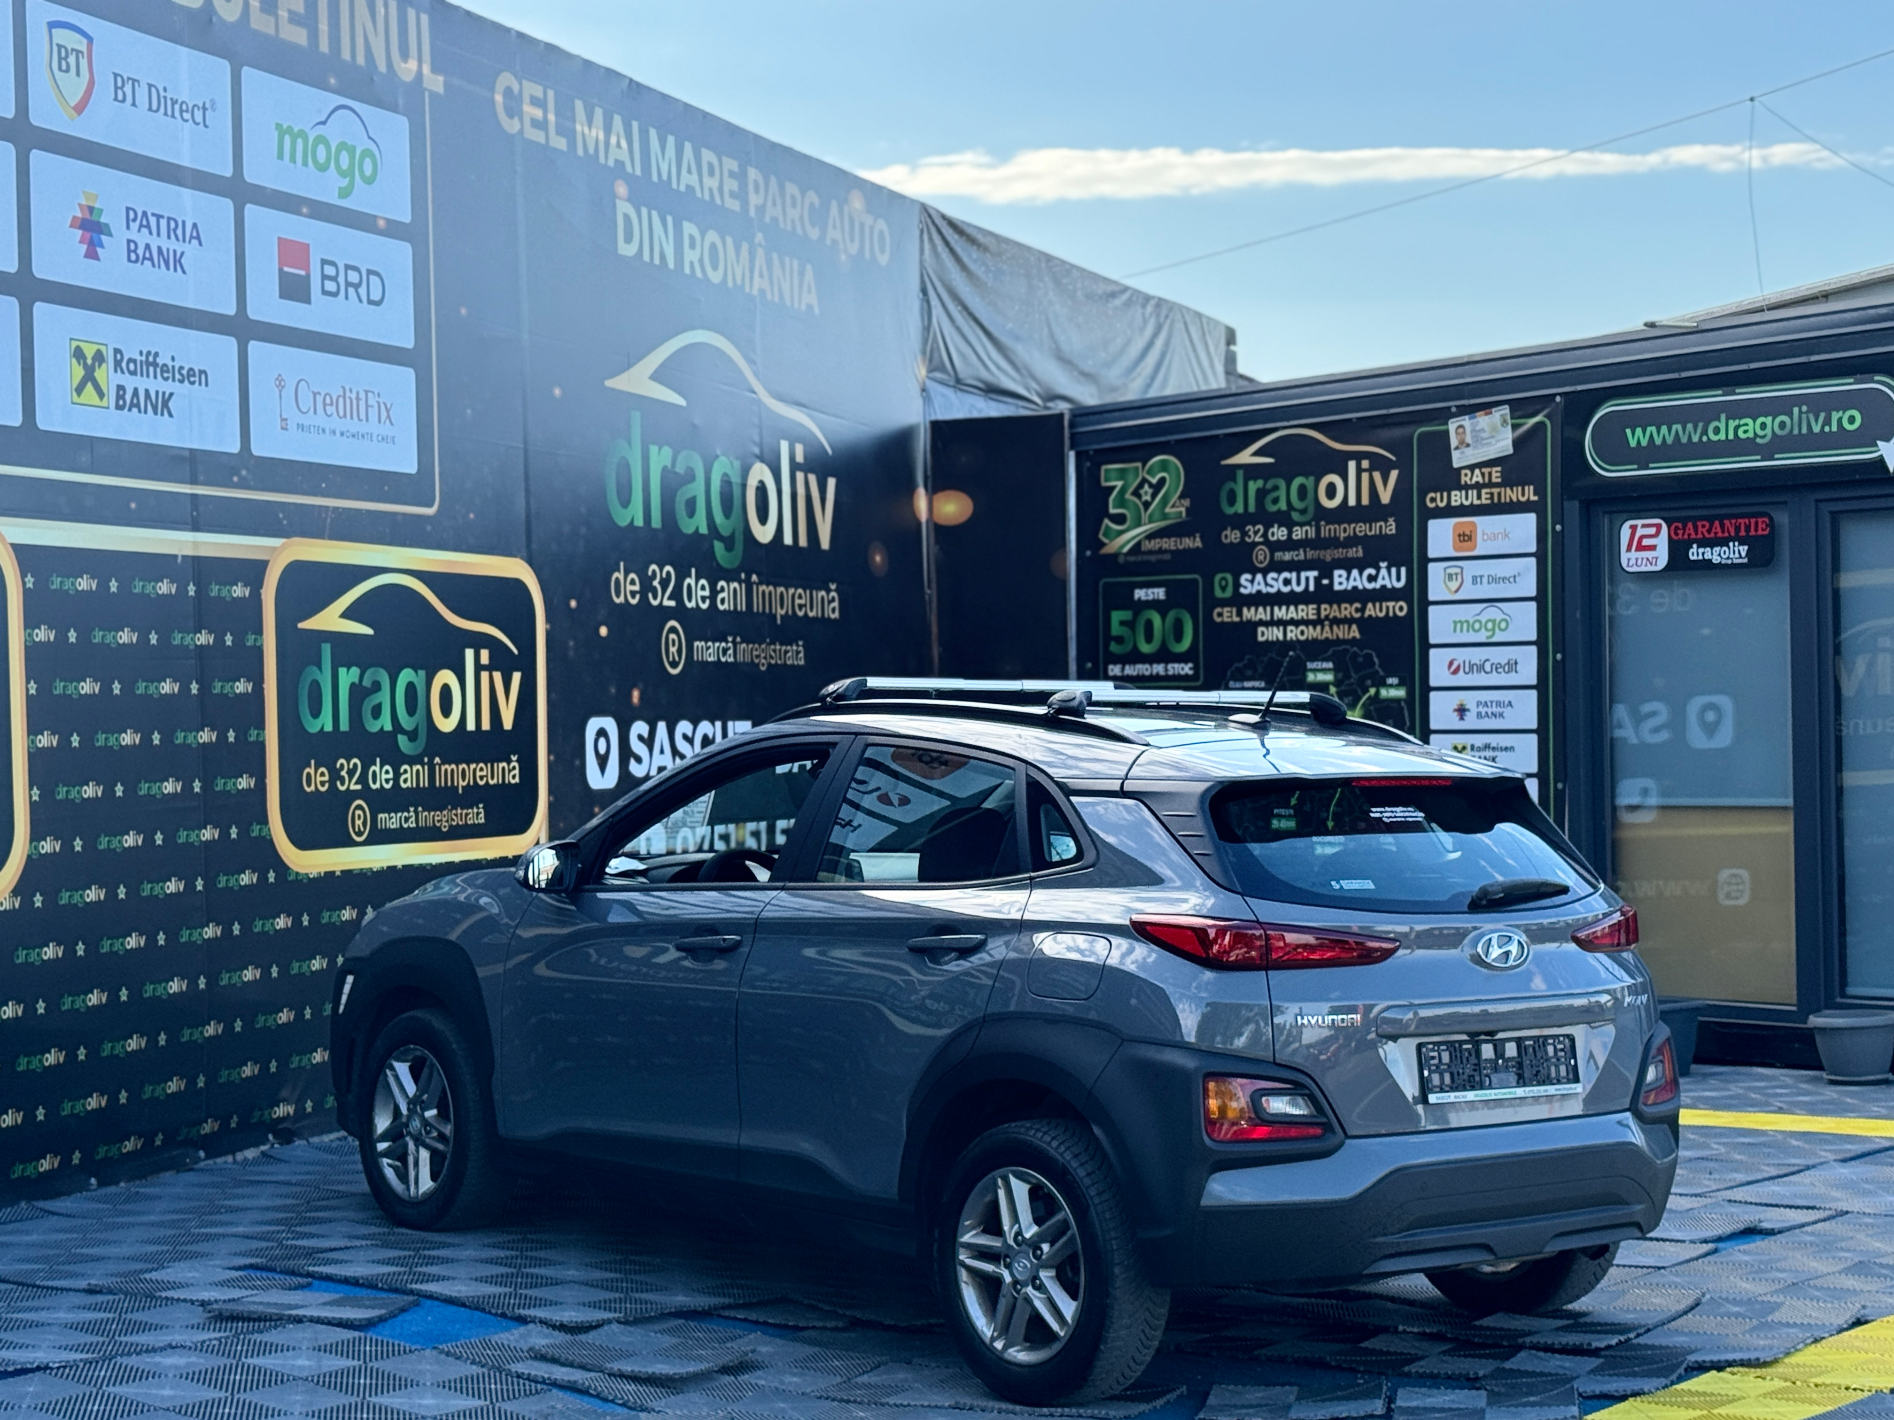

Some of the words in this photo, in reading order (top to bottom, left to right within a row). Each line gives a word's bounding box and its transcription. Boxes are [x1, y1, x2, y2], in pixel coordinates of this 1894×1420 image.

[55, 43, 85, 77] BT
[112, 71, 142, 106] BT
[275, 122, 378, 199] mogo
[494, 71, 567, 152] CEL
[574, 98, 642, 176] MAI
[648, 127, 741, 213] MARE
[746, 165, 821, 241] PARC
[825, 199, 890, 267] AUTO
[125, 205, 203, 248] PATRIA
[126, 238, 187, 275] BANK
[615, 198, 675, 270] DIN
[682, 232, 820, 315] ROMÂNIA
[320, 258, 386, 307] BRD
[112, 348, 209, 388] Raiffeisen
[114, 384, 175, 419] BANK
[294, 378, 395, 426] CreditFix
[296, 422, 326, 436] PRIETEN
[329, 427, 338, 437] IN
[339, 429, 374, 443] MOMENTE
[376, 433, 397, 445] CHEIE
[1625, 405, 1862, 447] www.dragoliv.ro
[605, 410, 836, 569] dragoliv
[1219, 460, 1399, 522] dragoliv
[1460, 467, 1502, 485] RATE
[1099, 455, 1185, 544] 32
[1425, 491, 1447, 508] CU
[1450, 485, 1538, 506] BULETINUL
[1221, 527, 1241, 543] de
[1245, 525, 1264, 542] 32
[1268, 523, 1287, 541] de
[1292, 522, 1315, 540] ani
[1320, 517, 1396, 542] împreună
[1457, 530, 1473, 544] tbi
[1481, 529, 1510, 543] bank
[1625, 522, 1662, 553] 12
[1669, 517, 1770, 540] GARANTIE
[1274, 547, 1305, 562] marcă
[1306, 545, 1363, 563] înregistrată
[1626, 556, 1659, 569] LUNI
[1688, 541, 1748, 565] dragoliv
[49, 574, 97, 594] dragoliv
[132, 579, 177, 597] dragoliv
[209, 582, 250, 601] dragoliv
[611, 561, 640, 605] de
[648, 564, 676, 607] 32
[683, 567, 710, 610] de
[716, 572, 746, 612] ani
[752, 575, 840, 625] împreună
[1134, 587, 1166, 600] PESTE
[1239, 571, 1318, 595] SASCUT
[1333, 561, 1407, 591] BACĂU
[1447, 572, 1460, 583] BT
[1471, 575, 1486, 586] BT
[1213, 607, 1240, 623] CEL
[1242, 605, 1271, 622] MAI
[1274, 603, 1317, 620] MARE
[1320, 602, 1361, 619] PARC
[1363, 601, 1408, 617] AUTO
[1452, 617, 1509, 640] mogo
[91, 628, 138, 647] dragoliv
[171, 630, 214, 649] dragoliv
[1108, 607, 1194, 655] 500
[1257, 626, 1284, 642] DIN
[1286, 621, 1361, 641] ROMÂNIA
[693, 636, 735, 663] marcă
[736, 637, 805, 670] înregistrată
[1108, 664, 1124, 677] DE
[1125, 664, 1152, 676] AUTO
[1153, 663, 1166, 675] PE
[1167, 663, 1194, 675] STOC
[1462, 658, 1519, 675] UniCredit
[52, 678, 100, 698] dragoliv
[135, 678, 180, 698] dragoliv
[211, 678, 253, 697] dragoliv
[298, 643, 522, 755] dragoliv
[1476, 699, 1514, 710] PATRIA
[1476, 711, 1505, 720] BANK
[94, 729, 141, 749] dragoliv
[173, 727, 217, 746] dragoliv
[629, 720, 753, 777] SASC
[1470, 743, 1515, 753] Raiffeisen
[55, 781, 103, 802] dragoliv
[137, 777, 182, 798] dragoliv
[213, 774, 256, 793] dragoliv
[302, 760, 329, 792] de
[336, 758, 362, 791] 32
[368, 758, 394, 789] de
[400, 758, 429, 788] ani
[434, 754, 520, 794] împreună
[378, 808, 416, 829] marcă
[418, 804, 485, 832] înregistrată
[97, 830, 144, 851] dragoliv
[176, 825, 220, 845] dragoliv
[57, 885, 106, 906] dragoliv
[140, 877, 185, 898] dragoliv
[216, 869, 258, 890] dragoliv
[15, 942, 64, 965] dragoliv
[100, 932, 146, 954] dragoliv
[179, 923, 222, 944] dragoliv
[252, 914, 292, 934] dragoliv
[320, 906, 358, 926] dragoliv
[60, 989, 108, 1011] dragoliv
[142, 977, 188, 999] dragoliv
[219, 965, 261, 986] dragoliv
[290, 955, 328, 975] dragoliv
[1297, 1013, 1361, 1027] HYUNDAI
[16, 1048, 66, 1072] dragoliv
[100, 1034, 147, 1057] dragoliv
[180, 1020, 224, 1043] dragoliv
[254, 1008, 295, 1029] dragoliv
[60, 1093, 108, 1116] dragoliv
[142, 1076, 187, 1099] dragoliv
[217, 1061, 260, 1084] dragoliv
[289, 1048, 329, 1068] dragoliv
[10, 1154, 61, 1179] dragoliv
[94, 1136, 144, 1160] dragoliv
[176, 1118, 221, 1141] dragoliv
[252, 1103, 295, 1123] dragoliv
